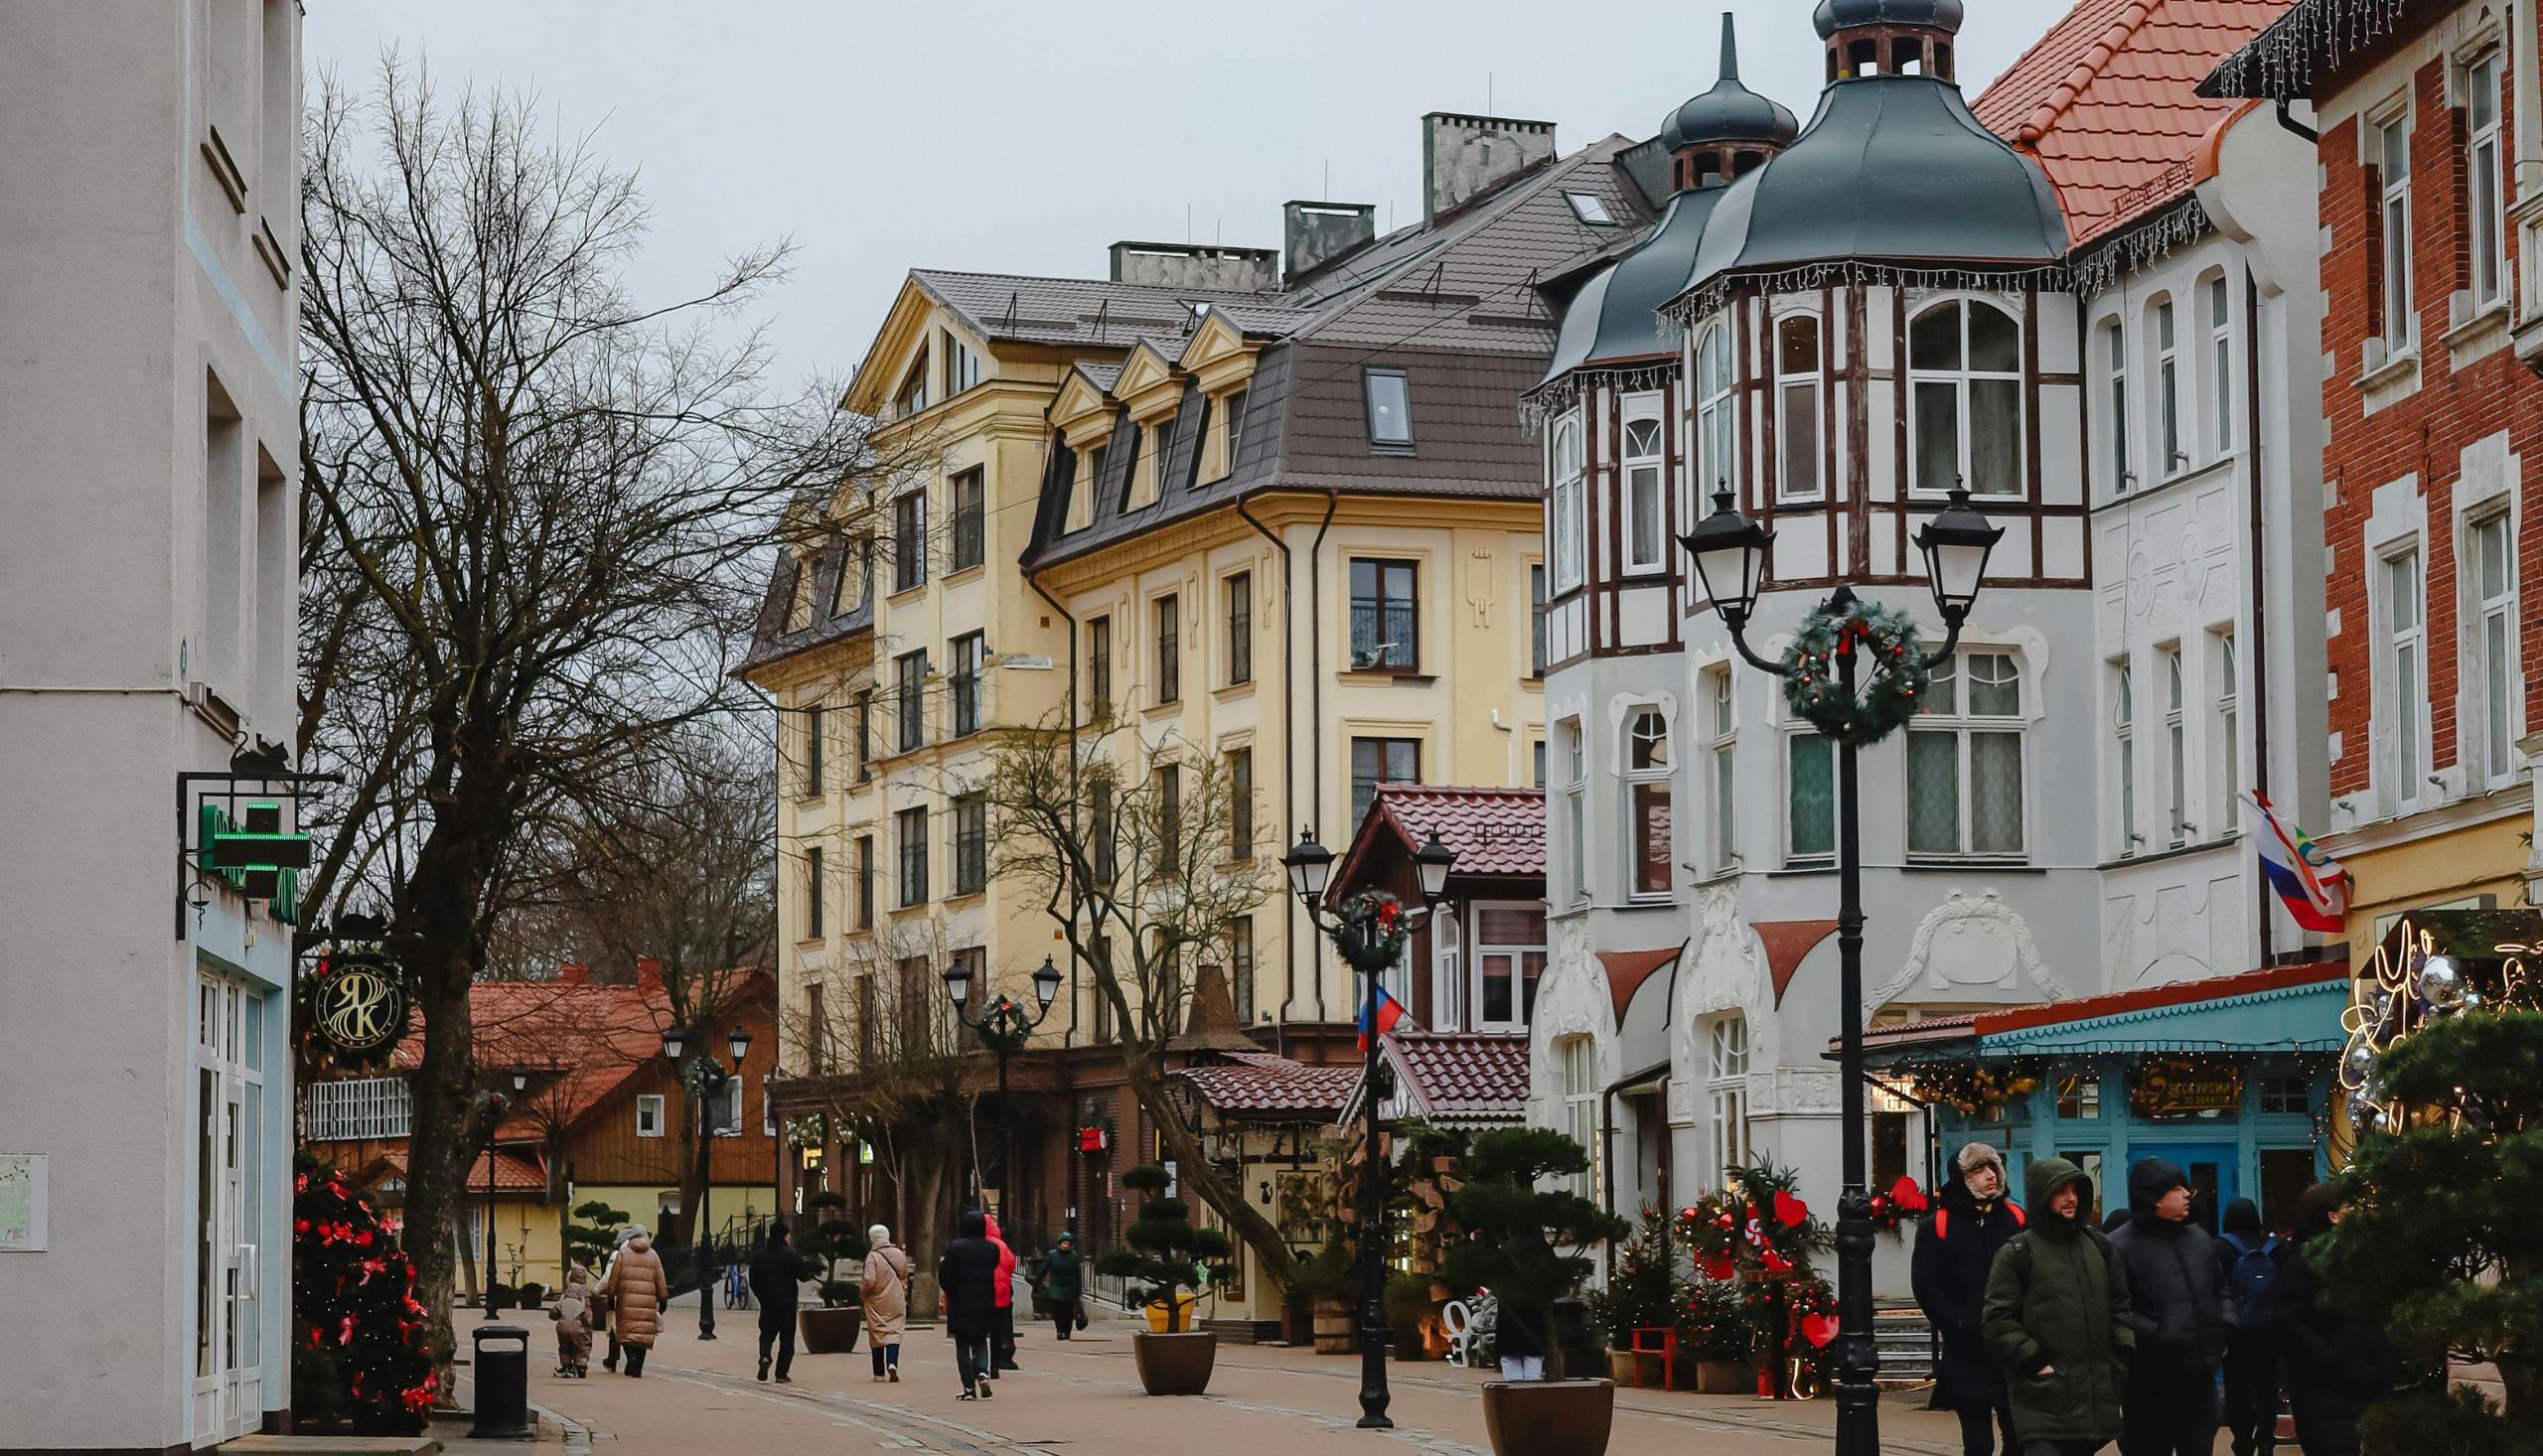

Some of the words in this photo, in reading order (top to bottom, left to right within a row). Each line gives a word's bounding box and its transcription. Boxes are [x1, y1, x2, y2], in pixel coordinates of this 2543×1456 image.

[322, 1020, 392, 1046] КОМБИНАТ
[2168, 1083, 2230, 1095] ЭКСКУРСИИ
[2195, 1095, 2230, 1104] ОБЛАСТИ
